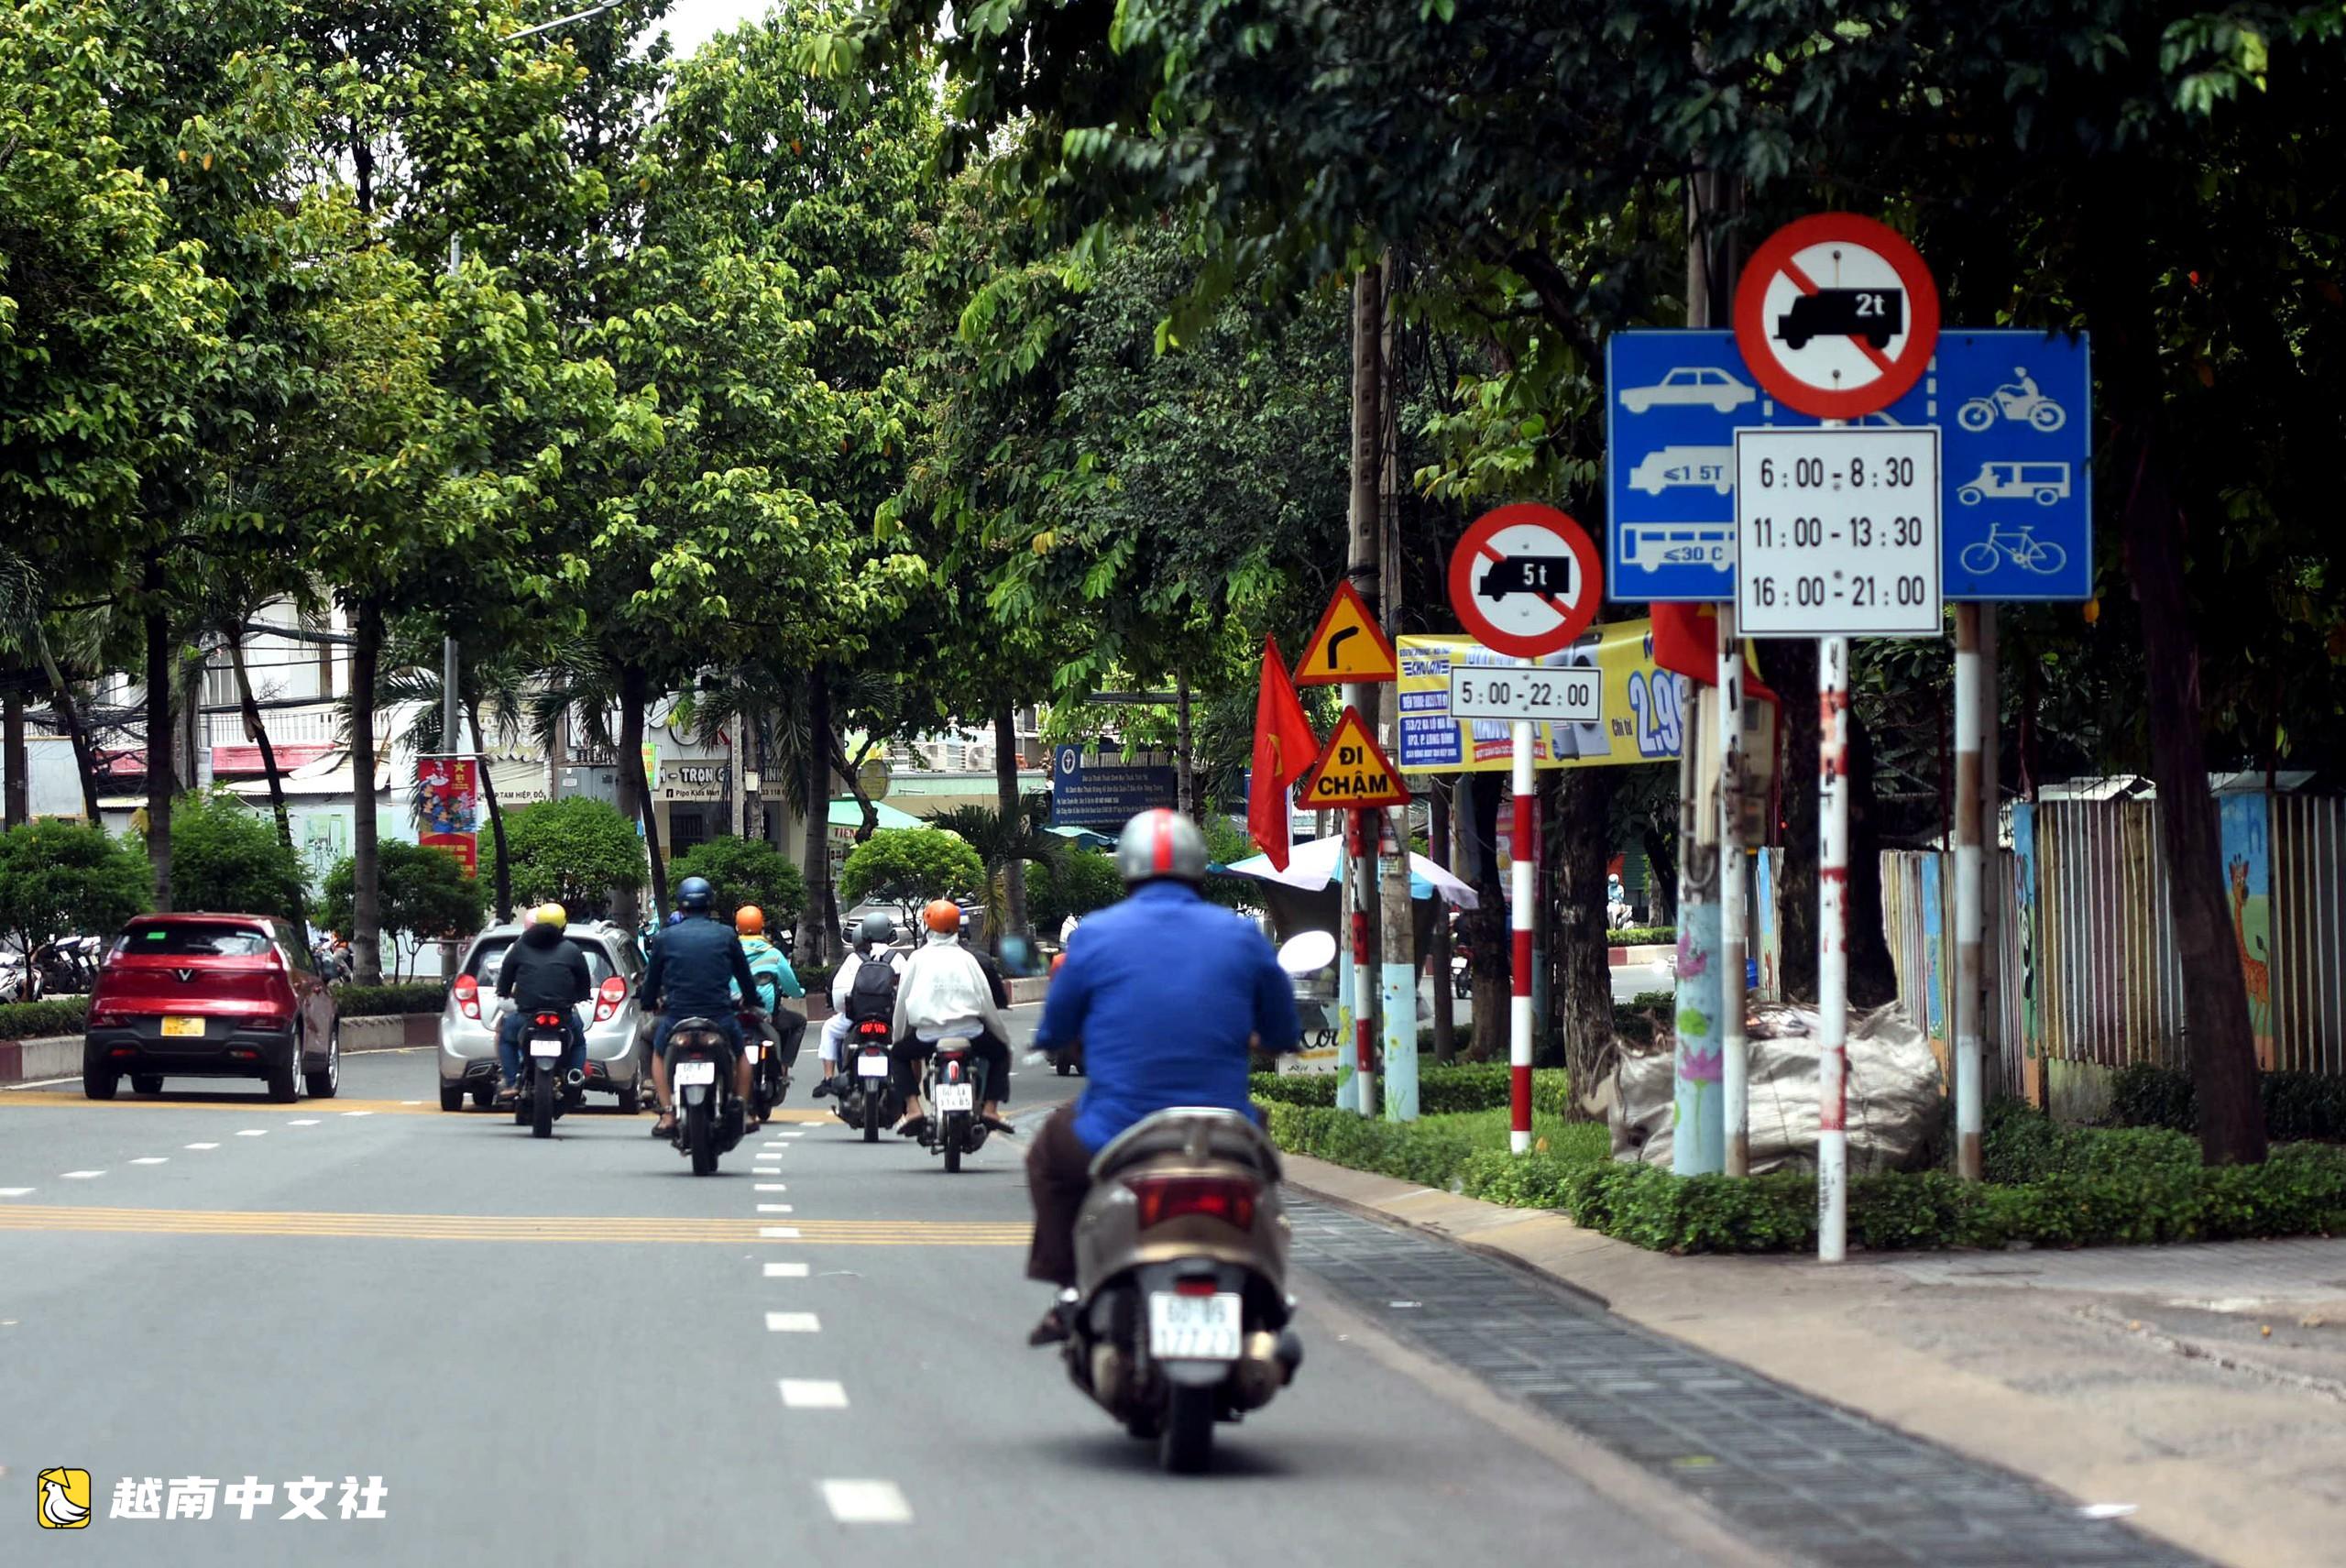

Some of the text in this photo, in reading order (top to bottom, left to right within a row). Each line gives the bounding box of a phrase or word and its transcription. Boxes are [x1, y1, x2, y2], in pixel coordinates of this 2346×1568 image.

[1855, 293, 1885, 316] 2t
[1339, 746, 1364, 765] ĐI
[681, 767, 714, 786] TRỌN
[1318, 771, 1388, 800] CHẬM
